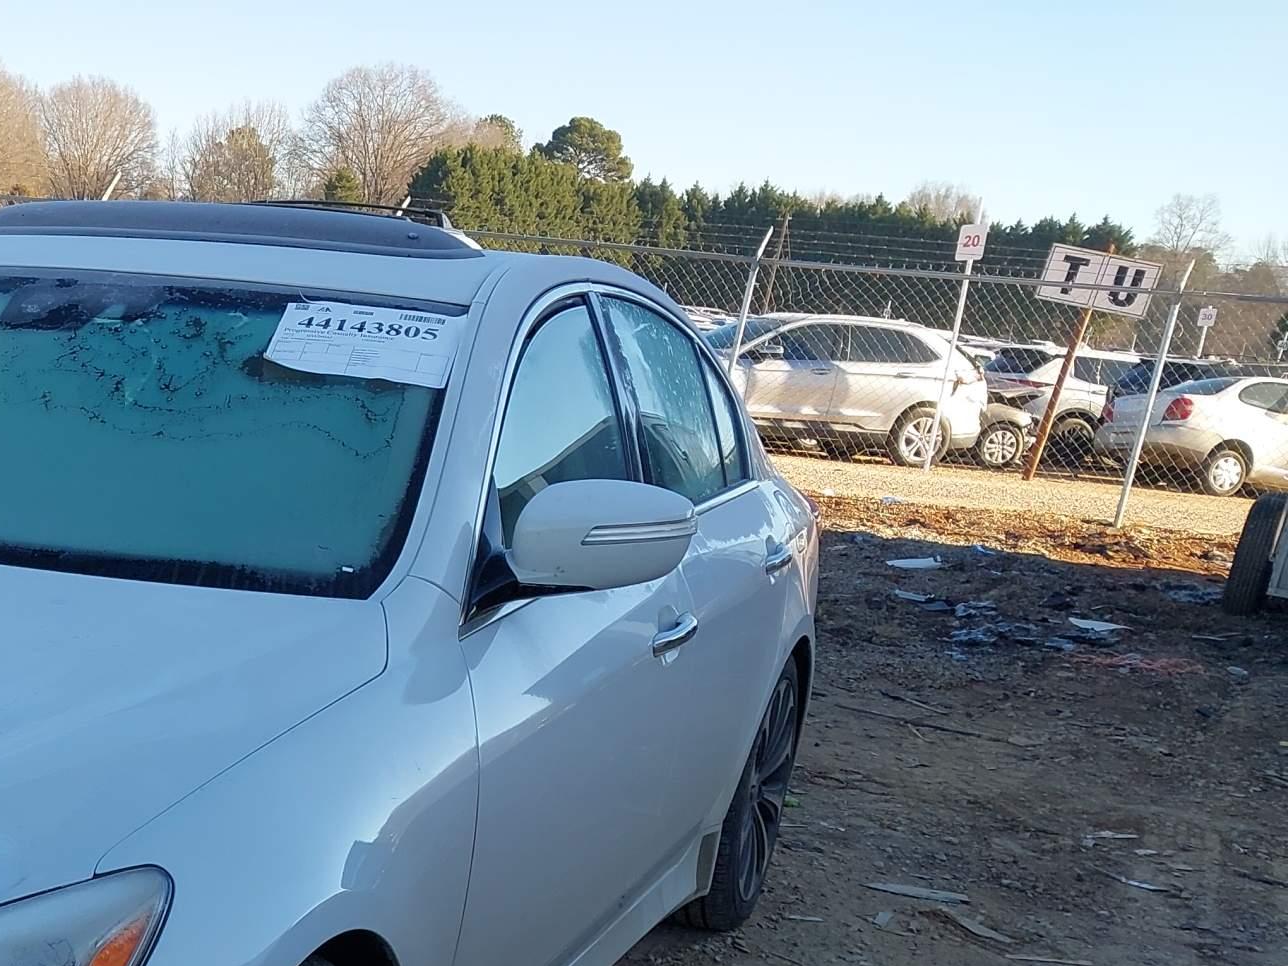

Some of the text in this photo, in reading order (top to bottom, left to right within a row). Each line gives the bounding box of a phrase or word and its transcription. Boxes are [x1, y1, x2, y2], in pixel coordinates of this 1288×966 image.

[963, 234, 981, 248] 20
[1060, 254, 1147, 308] T U
[1201, 312, 1213, 321] 30
[297, 316, 440, 341] 44143805
